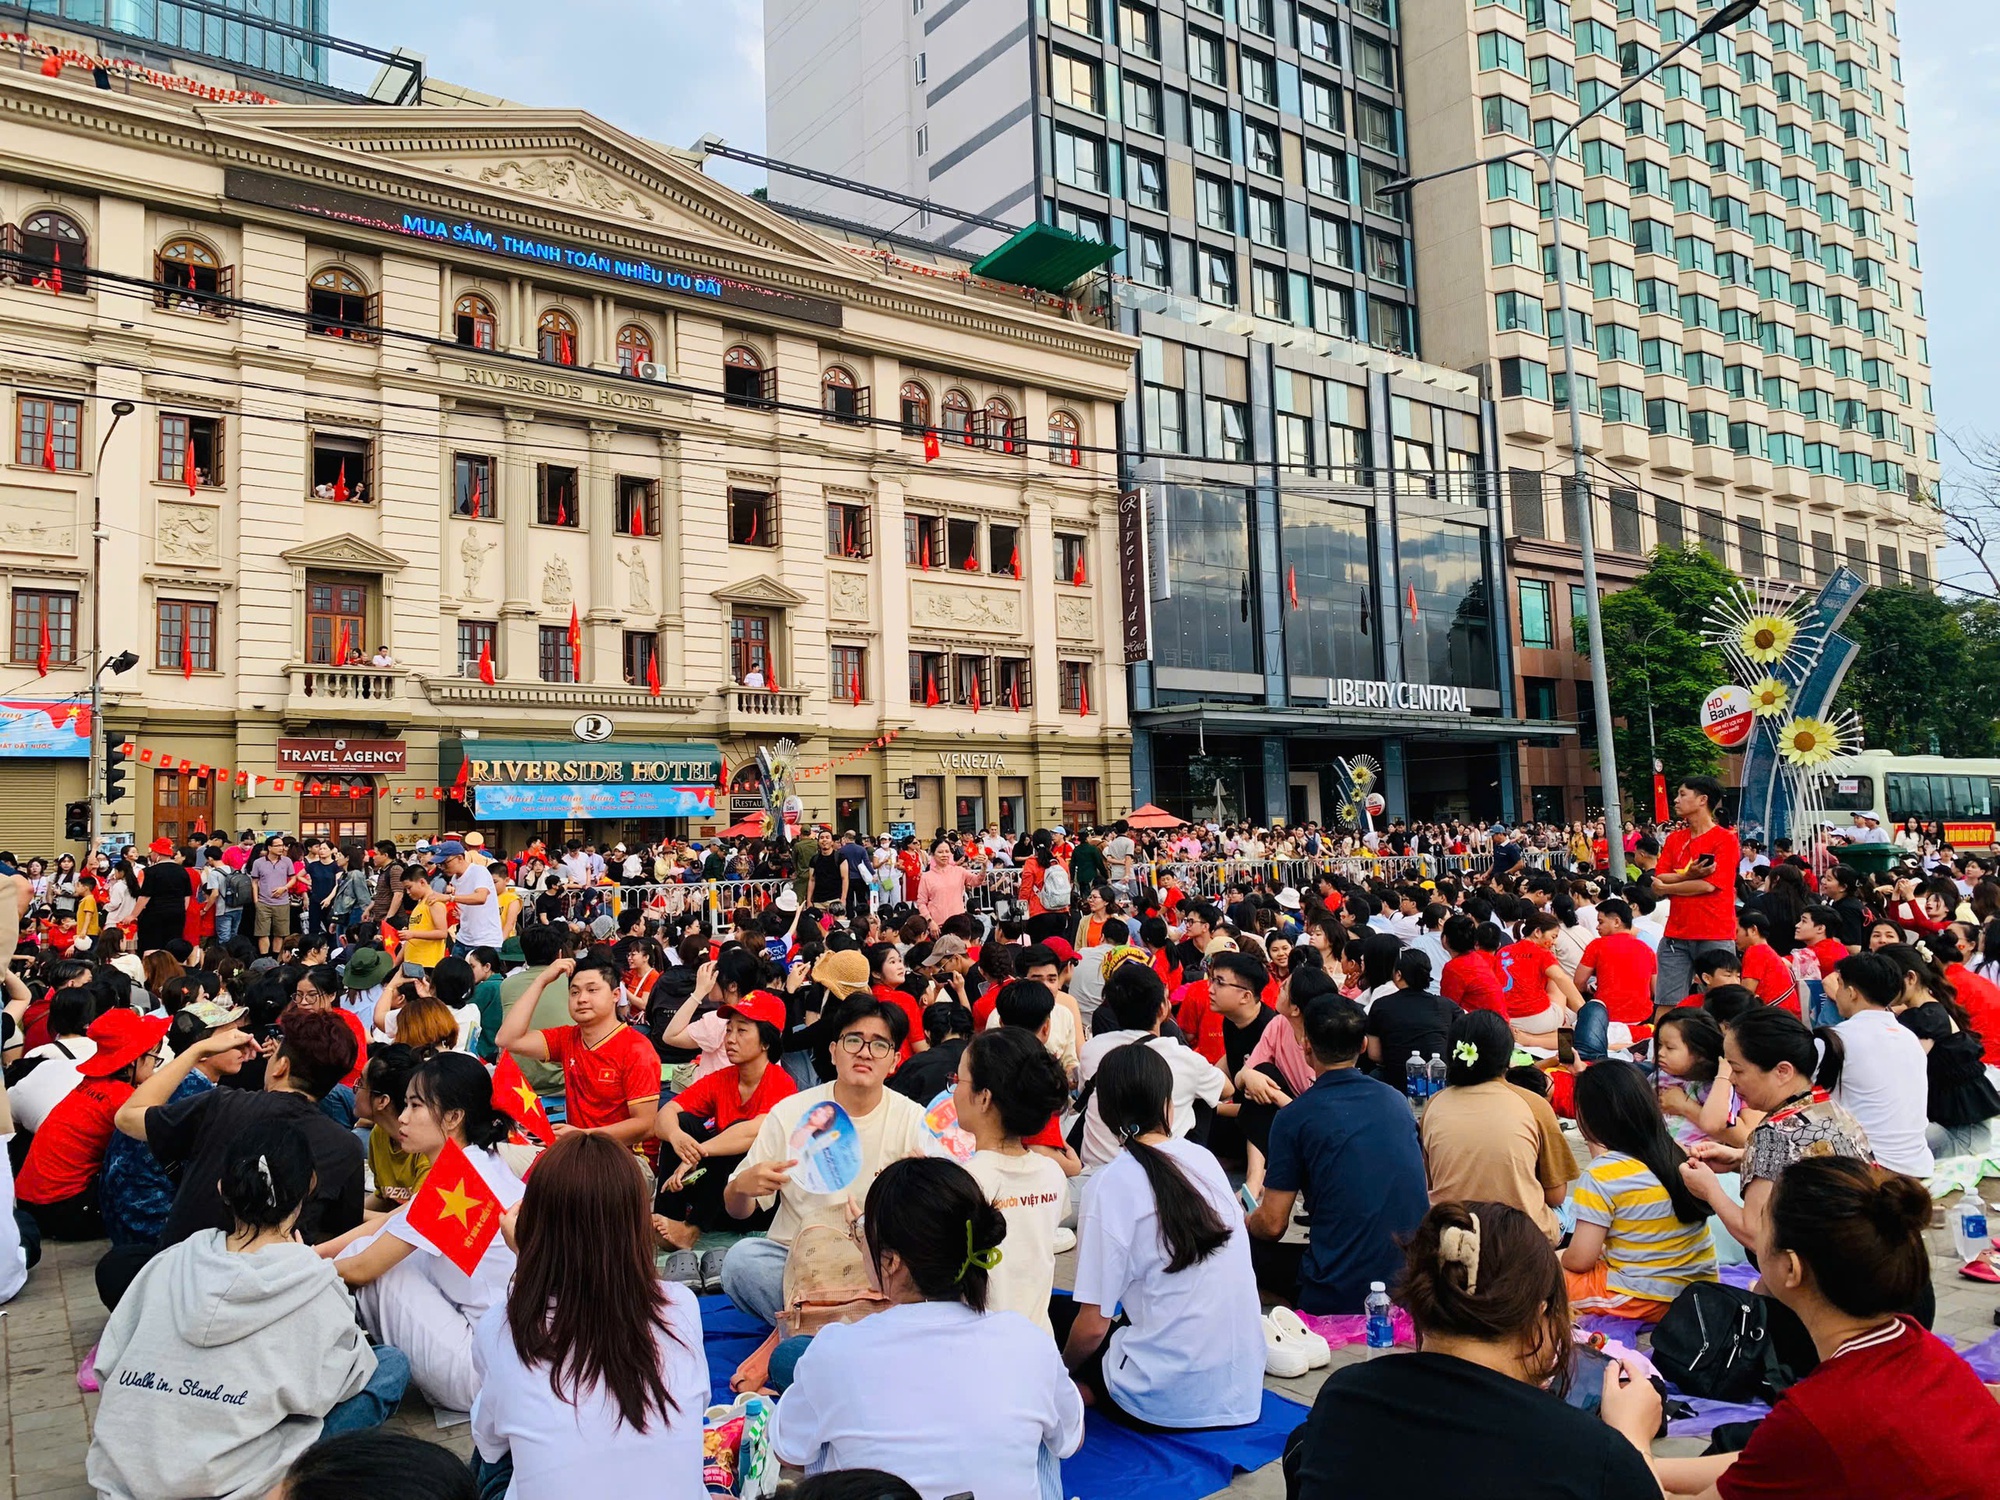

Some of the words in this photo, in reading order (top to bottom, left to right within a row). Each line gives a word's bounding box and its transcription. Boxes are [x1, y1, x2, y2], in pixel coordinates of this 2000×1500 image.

[402, 213, 449, 239] MUA
[452, 221, 499, 252] SẮM,
[501, 235, 562, 263] THANH
[564, 246, 611, 274] TOÁN
[614, 259, 663, 287] NHIỀU
[665, 271, 692, 290] ƯU
[463, 367, 583, 400] RIVERSIDE
[596, 388, 663, 413] HOTEL
[1328, 677, 1396, 708] LIBERTY
[1397, 682, 1472, 713] CENTRAL
[1707, 697, 1723, 711] HD
[1710, 704, 1737, 722] Bank
[281, 749, 338, 762] TRAVEL
[342, 750, 403, 763] AGENCY
[938, 753, 1005, 769] VENEZIA
[470, 759, 624, 782] RIVERSIDE
[631, 760, 718, 782] HOTEL
[735, 799, 762, 807] RESTAU
[1020, 1193, 1039, 1208] VIỆT
[119, 1370, 156, 1391] Walk
[156, 1377, 174, 1394] in,
[179, 1378, 224, 1401] Stand
[222, 1390, 249, 1406] out
